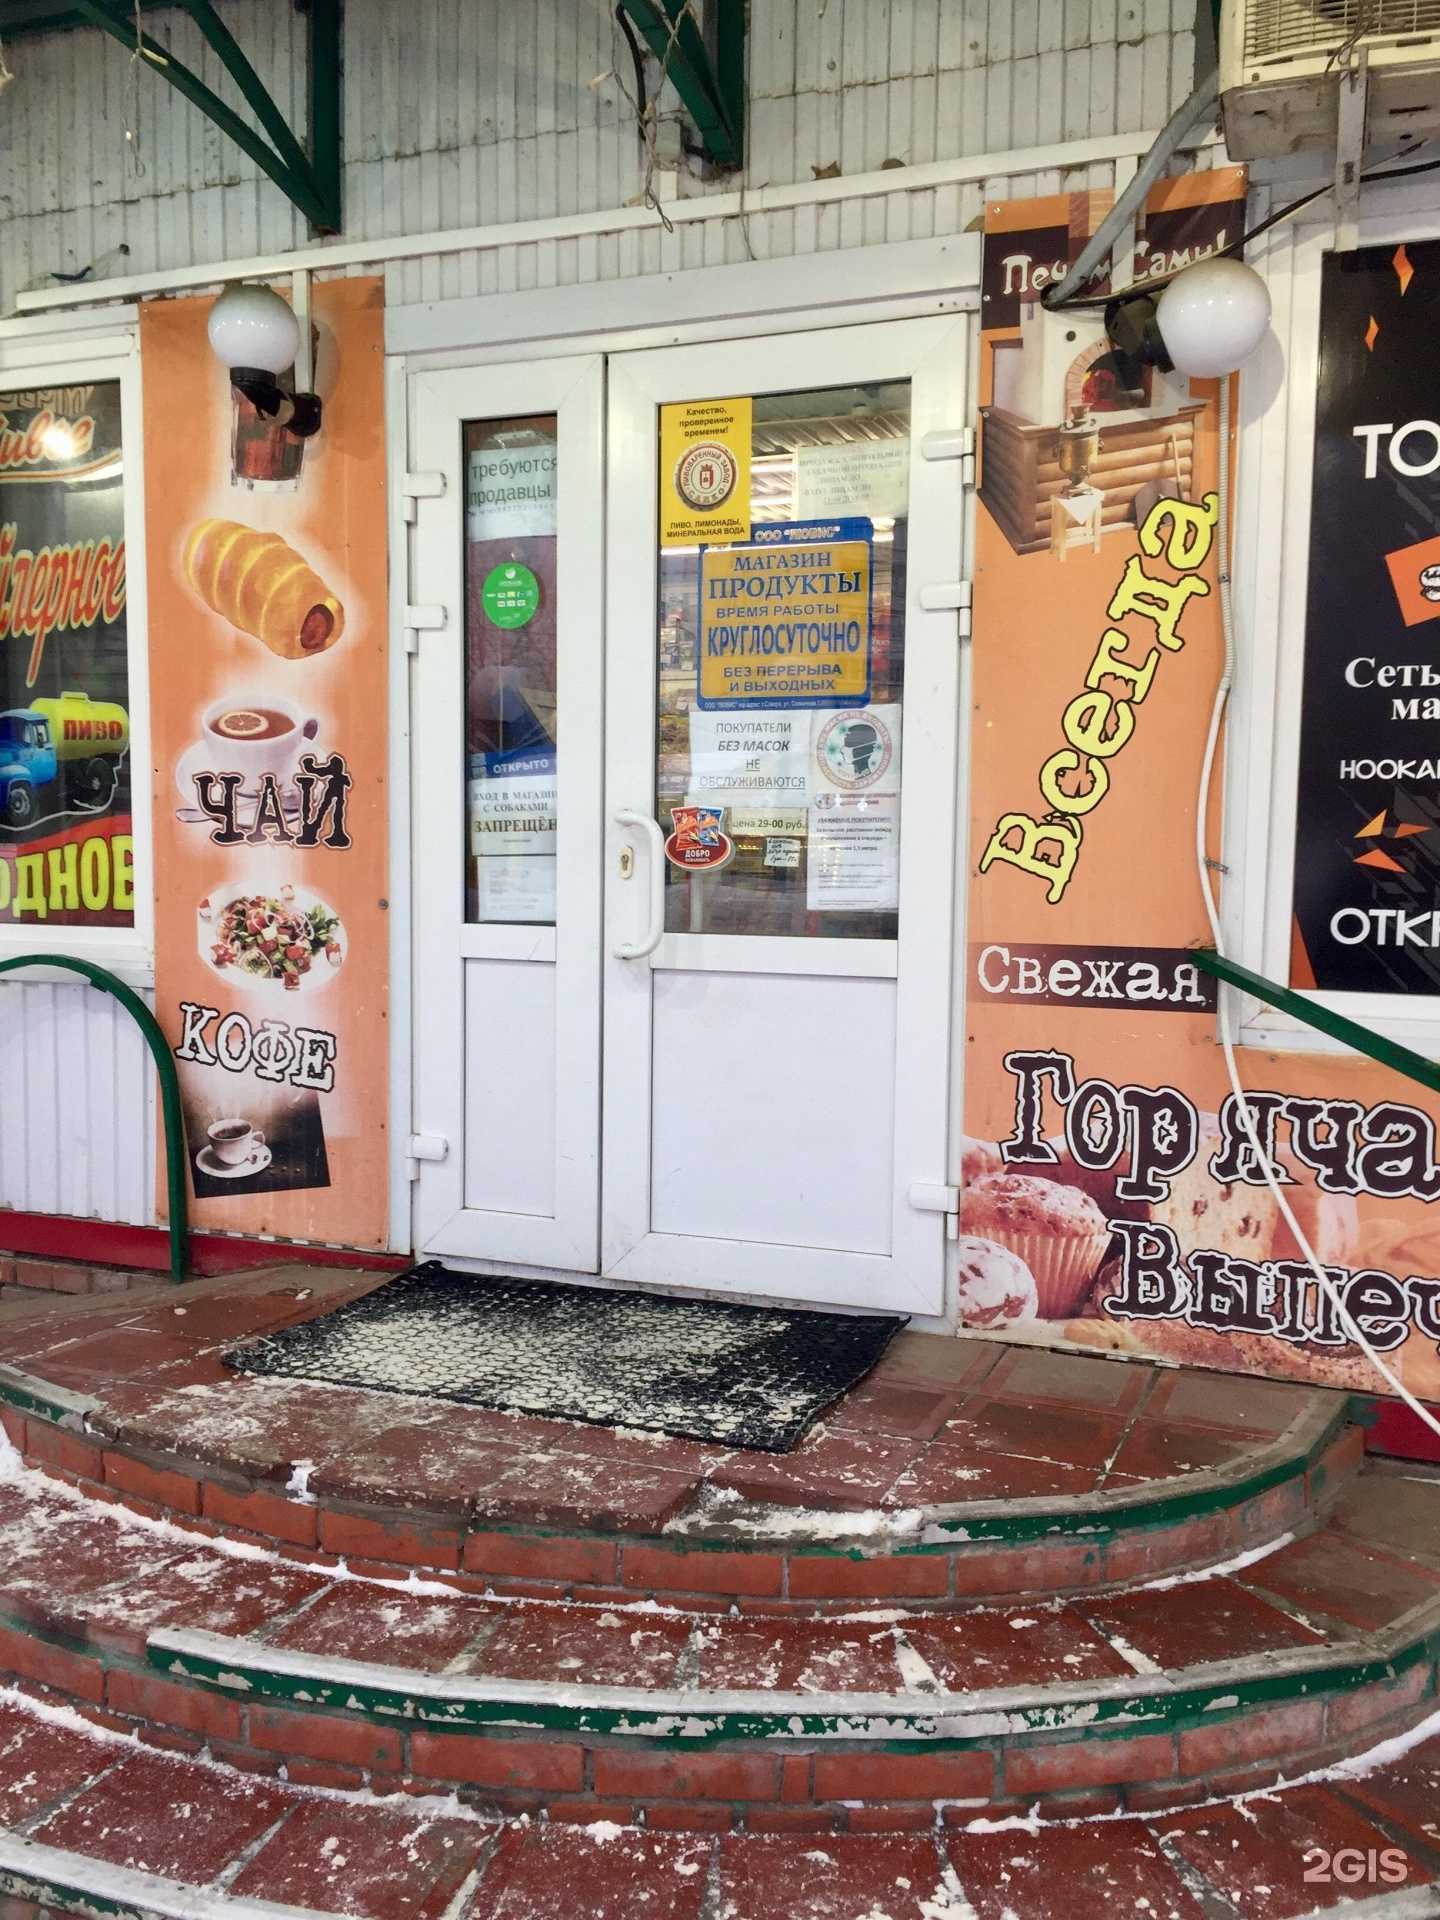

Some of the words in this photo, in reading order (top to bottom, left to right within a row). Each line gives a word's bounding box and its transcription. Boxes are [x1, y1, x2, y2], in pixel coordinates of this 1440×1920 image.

[686, 406, 727, 416] Качество,
[679, 416, 734, 428] проверенное
[684, 426, 729, 438] временем!
[471, 457, 557, 482] требуются
[468, 484, 551, 508] продавцы
[666, 529, 721, 538] МИНЕРАЛЬНАЯ
[723, 527, 745, 536] ВОДА
[734, 551, 833, 572] МАГАЗИН
[709, 572, 862, 600] ПРОДУКТЫ
[716, 606, 768, 619] ВРЕМЯ
[773, 603, 839, 617] РАБОТЫ
[708, 620, 861, 656] КРУГЛОСУТОЧНО
[723, 666, 752, 678] БЕЗ
[756, 664, 843, 677] ПЕРЕРЫВА
[1344, 656, 1440, 689] Сеть
[730, 682, 739, 692] И
[744, 679, 836, 692] ВЫХОДНЫХ
[979, 492, 1220, 905] Всегда
[64, 719, 123, 741] ПИВО
[716, 722, 792, 734] ПОКУПАТЕЛИ
[718, 741, 740, 752] БЕЗ
[743, 740, 790, 752] МАСОК
[493, 758, 549, 773] ОТКРЫТО
[746, 759, 760, 769] НЕ
[1340, 759, 1440, 780] HOOKA
[699, 776, 806, 788] ОБСЛУЖИВАЮТСЯ
[193, 752, 352, 849] ЧАЙ
[494, 801, 548, 812] СОБАКАМИ
[758, 819, 784, 829] 29-00
[685, 849, 710, 858] ДОБРО
[977, 945, 1206, 1003] Свежая
[175, 1001, 337, 1093] КОФЕ
